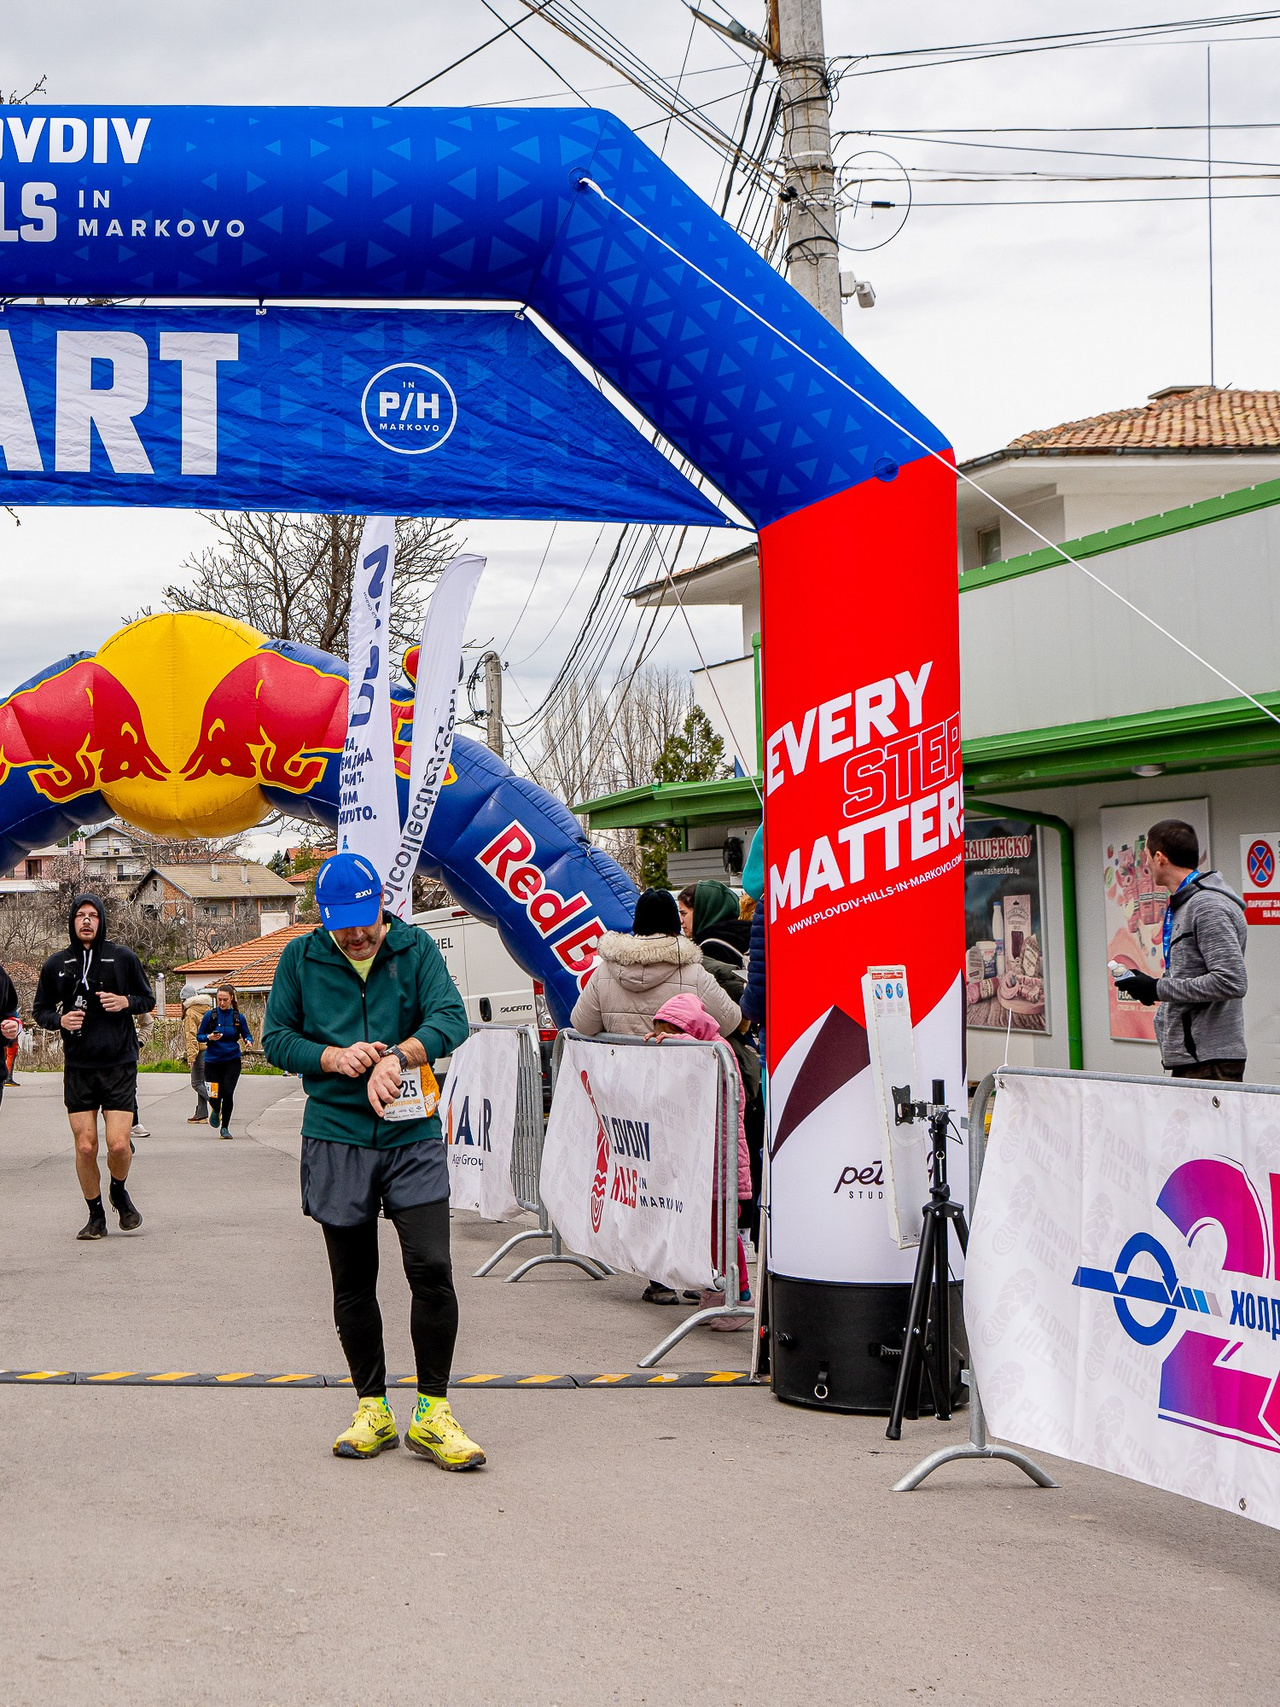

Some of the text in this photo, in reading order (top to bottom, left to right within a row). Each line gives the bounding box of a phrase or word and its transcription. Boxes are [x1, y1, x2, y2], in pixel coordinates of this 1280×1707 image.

[78, 190, 110, 208] IN
[78, 218, 246, 238] MARKOVO
[379, 392, 440, 421] P/H
[379, 423, 440, 431] MARKOVO
[767, 661, 933, 797] EVERY
[843, 711, 960, 818] STEP
[477, 822, 590, 938] Red
[355, 888, 373, 899] 2XU
[787, 852, 963, 935] WWW.PLOVDIV-HILLS-IN-MARKOVO.COM
[500, 1004, 533, 1014] DUCATO
